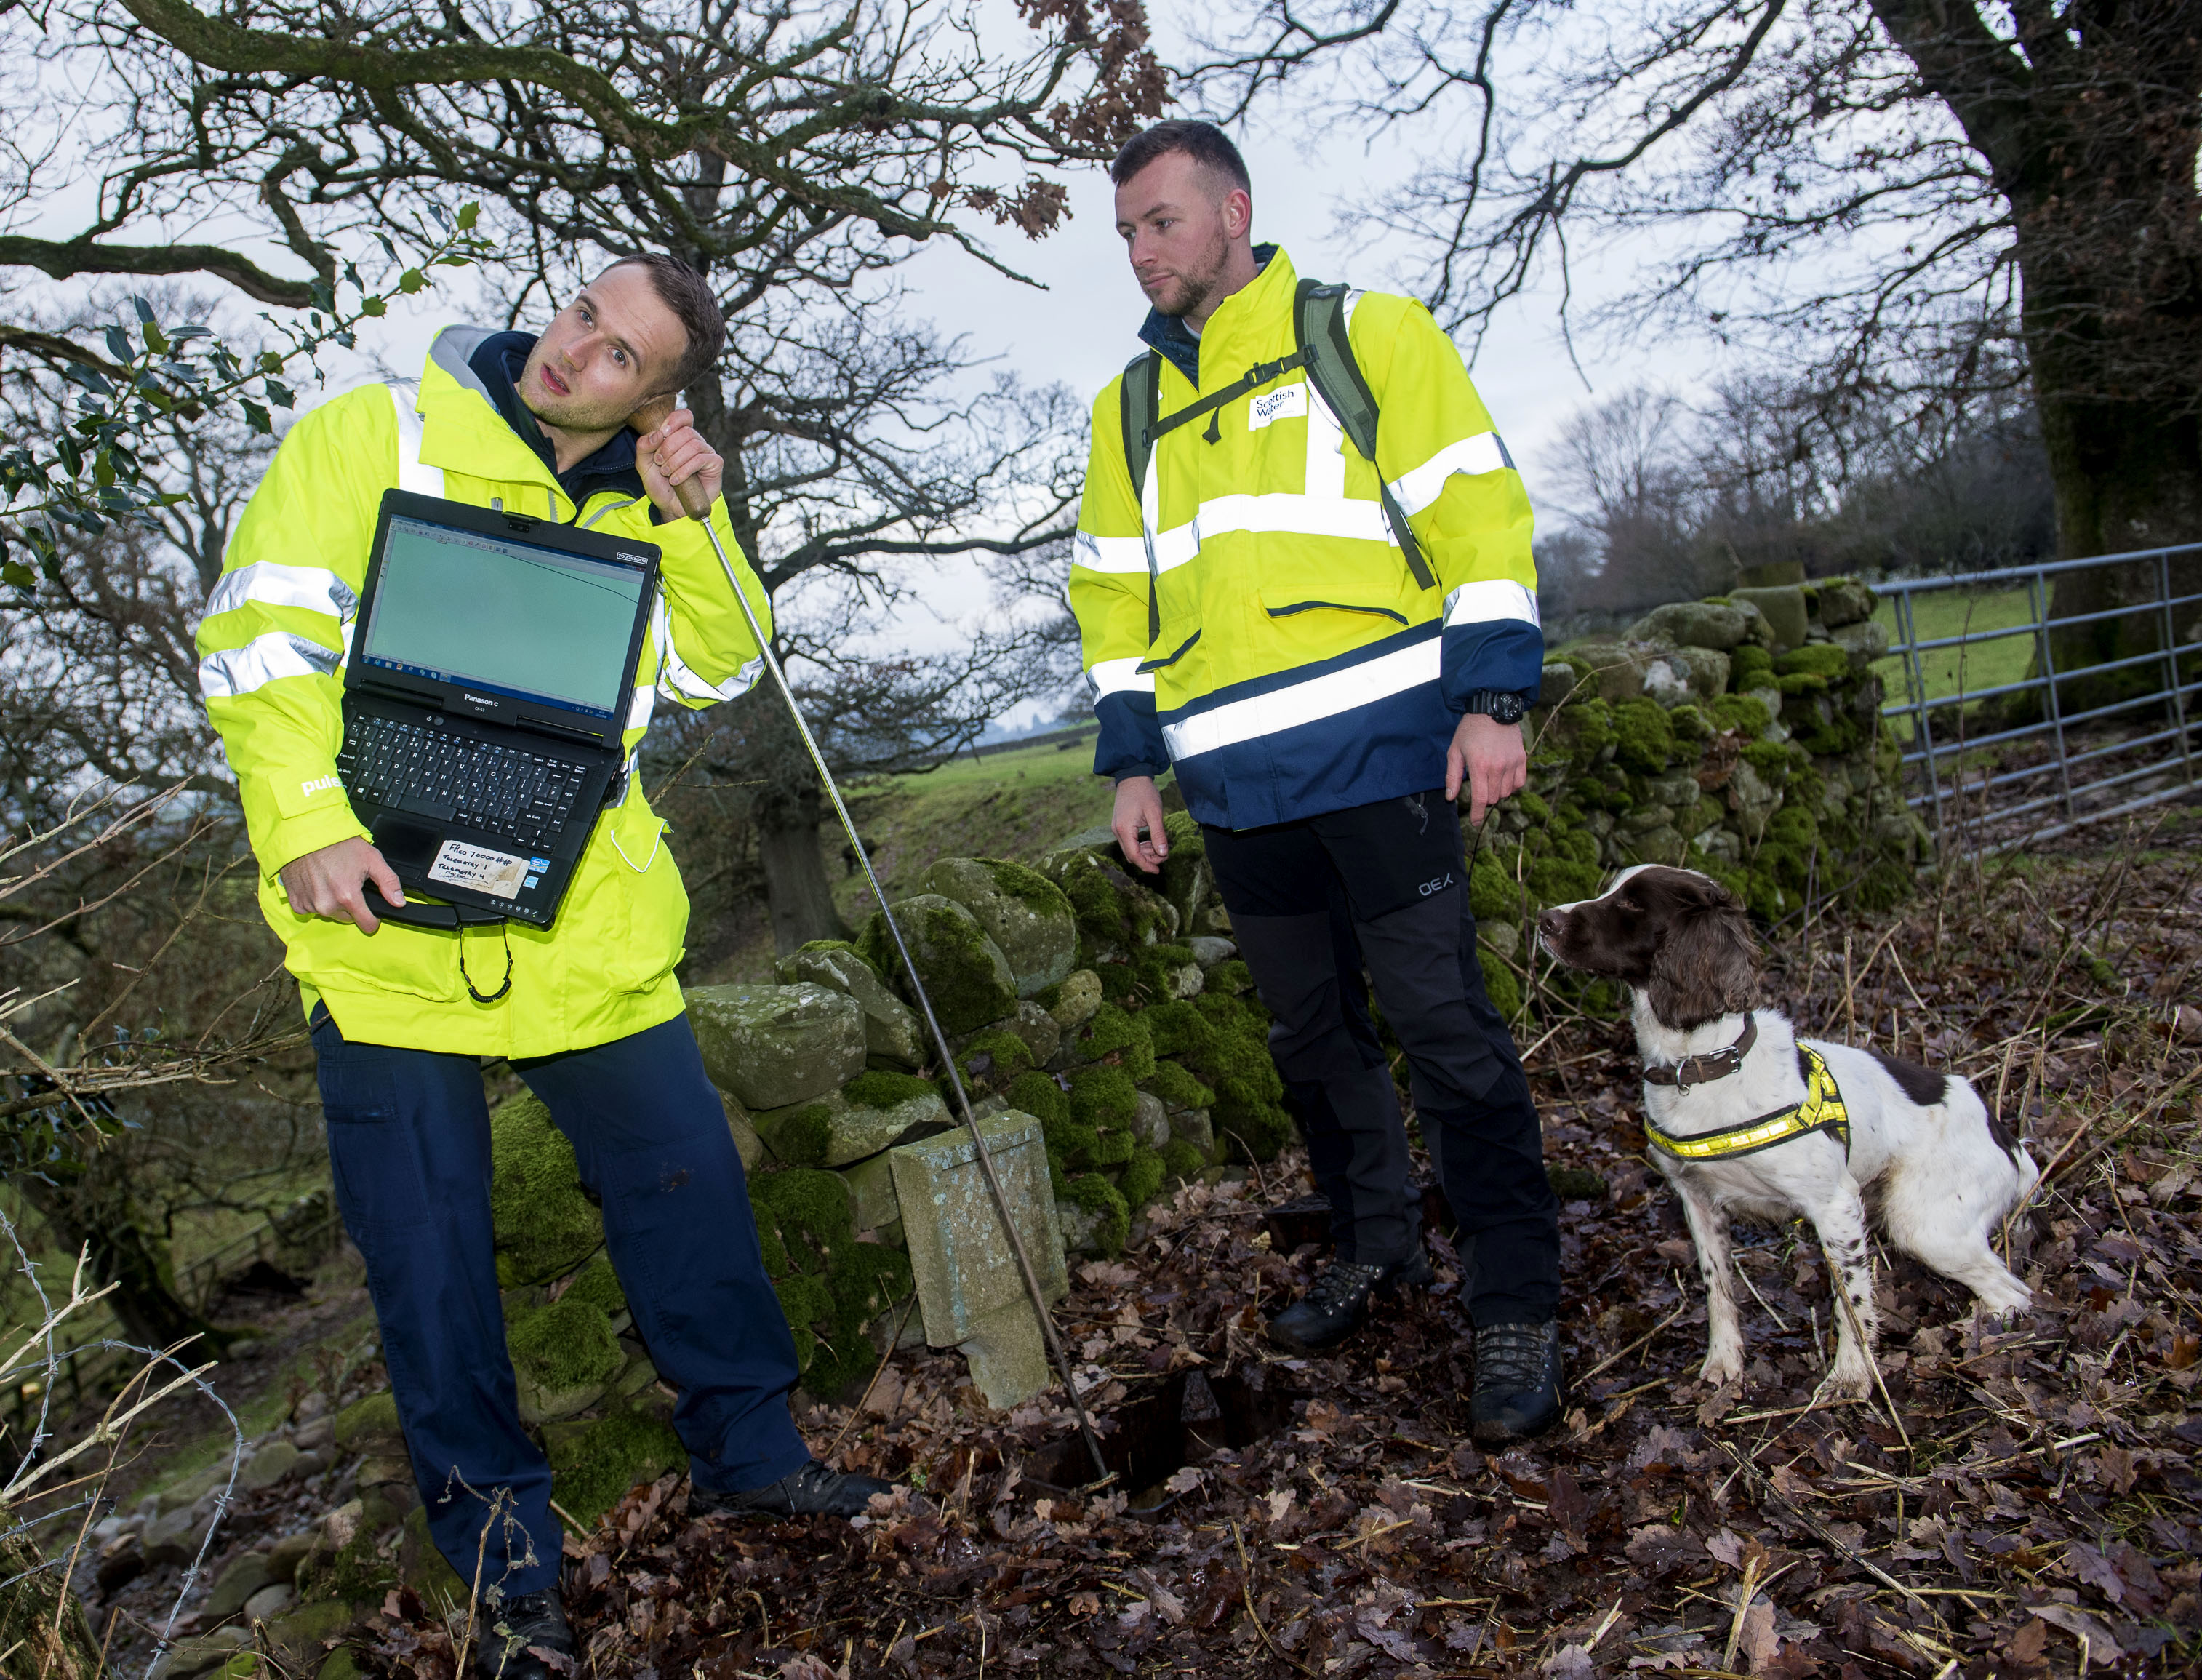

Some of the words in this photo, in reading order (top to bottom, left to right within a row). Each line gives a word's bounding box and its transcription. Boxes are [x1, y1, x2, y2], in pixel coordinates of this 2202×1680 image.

[1257, 390, 1294, 409] Scottish
[1257, 401, 1284, 417] Water
[618, 553, 646, 563] TOUGHBOOK
[465, 693, 499, 707] Panasonc
[470, 851, 495, 861] 70000
[1419, 873, 1453, 896] OEX
